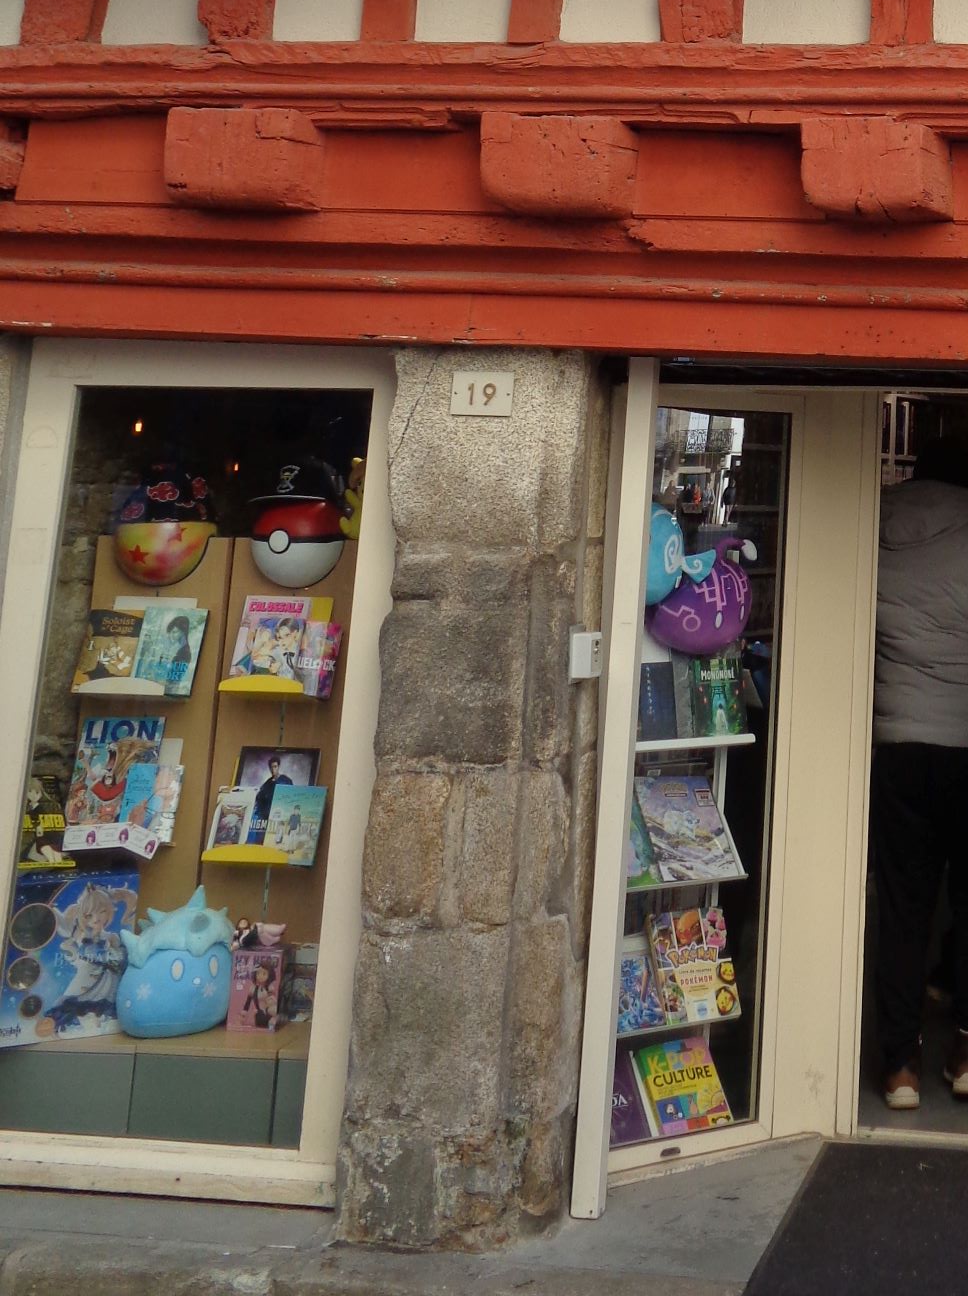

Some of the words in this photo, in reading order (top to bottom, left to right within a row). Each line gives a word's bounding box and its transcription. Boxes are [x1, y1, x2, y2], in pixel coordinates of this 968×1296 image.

[467, 383, 497, 406] 19
[85, 719, 159, 744] LION
[647, 1048, 705, 1074] K-POP
[653, 1065, 713, 1088] CULTURE
